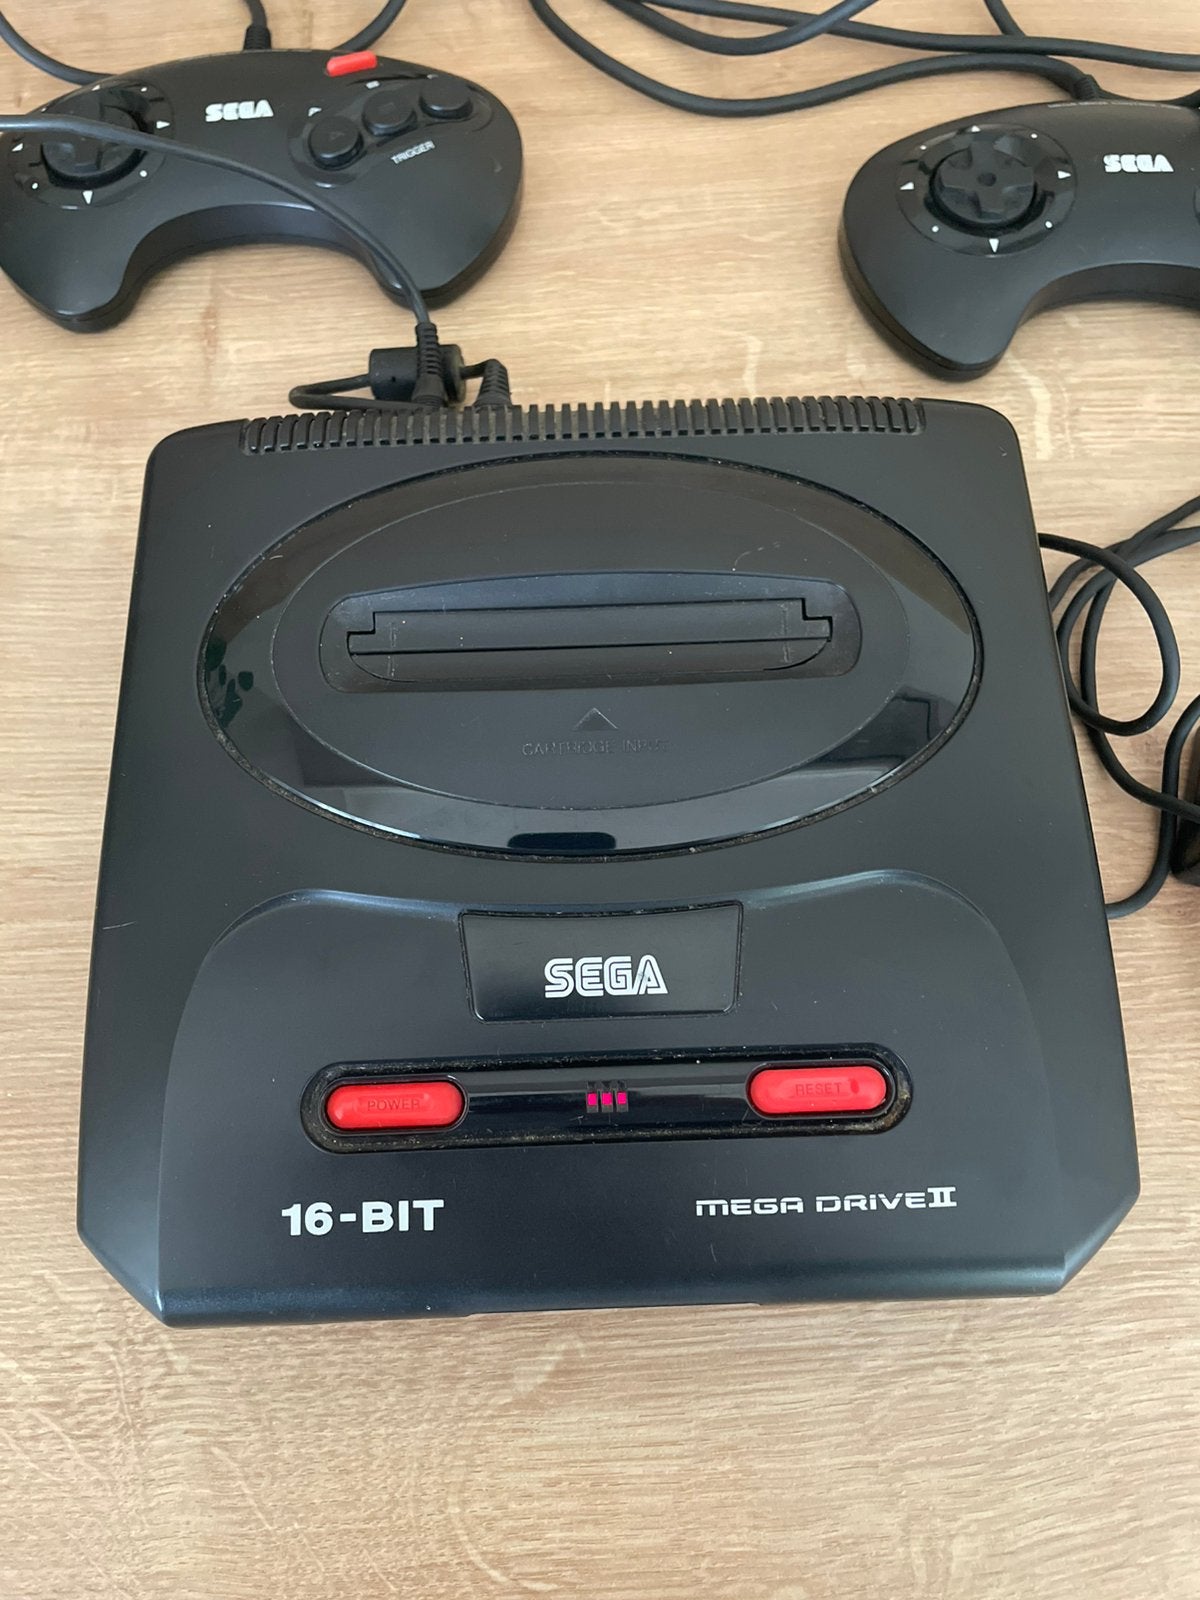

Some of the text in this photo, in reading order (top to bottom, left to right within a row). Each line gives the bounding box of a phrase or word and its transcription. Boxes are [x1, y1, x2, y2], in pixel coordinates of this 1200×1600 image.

[205, 99, 274, 122] SEGA
[390, 139, 436, 164] TRIGGER
[1103, 153, 1174, 173] SEGA
[544, 954, 669, 998] SEGA
[795, 1081, 842, 1096] RESET
[367, 1098, 422, 1112] POWER
[696, 1197, 804, 1216] MEGA
[281, 1199, 444, 1236] 16-BIT
